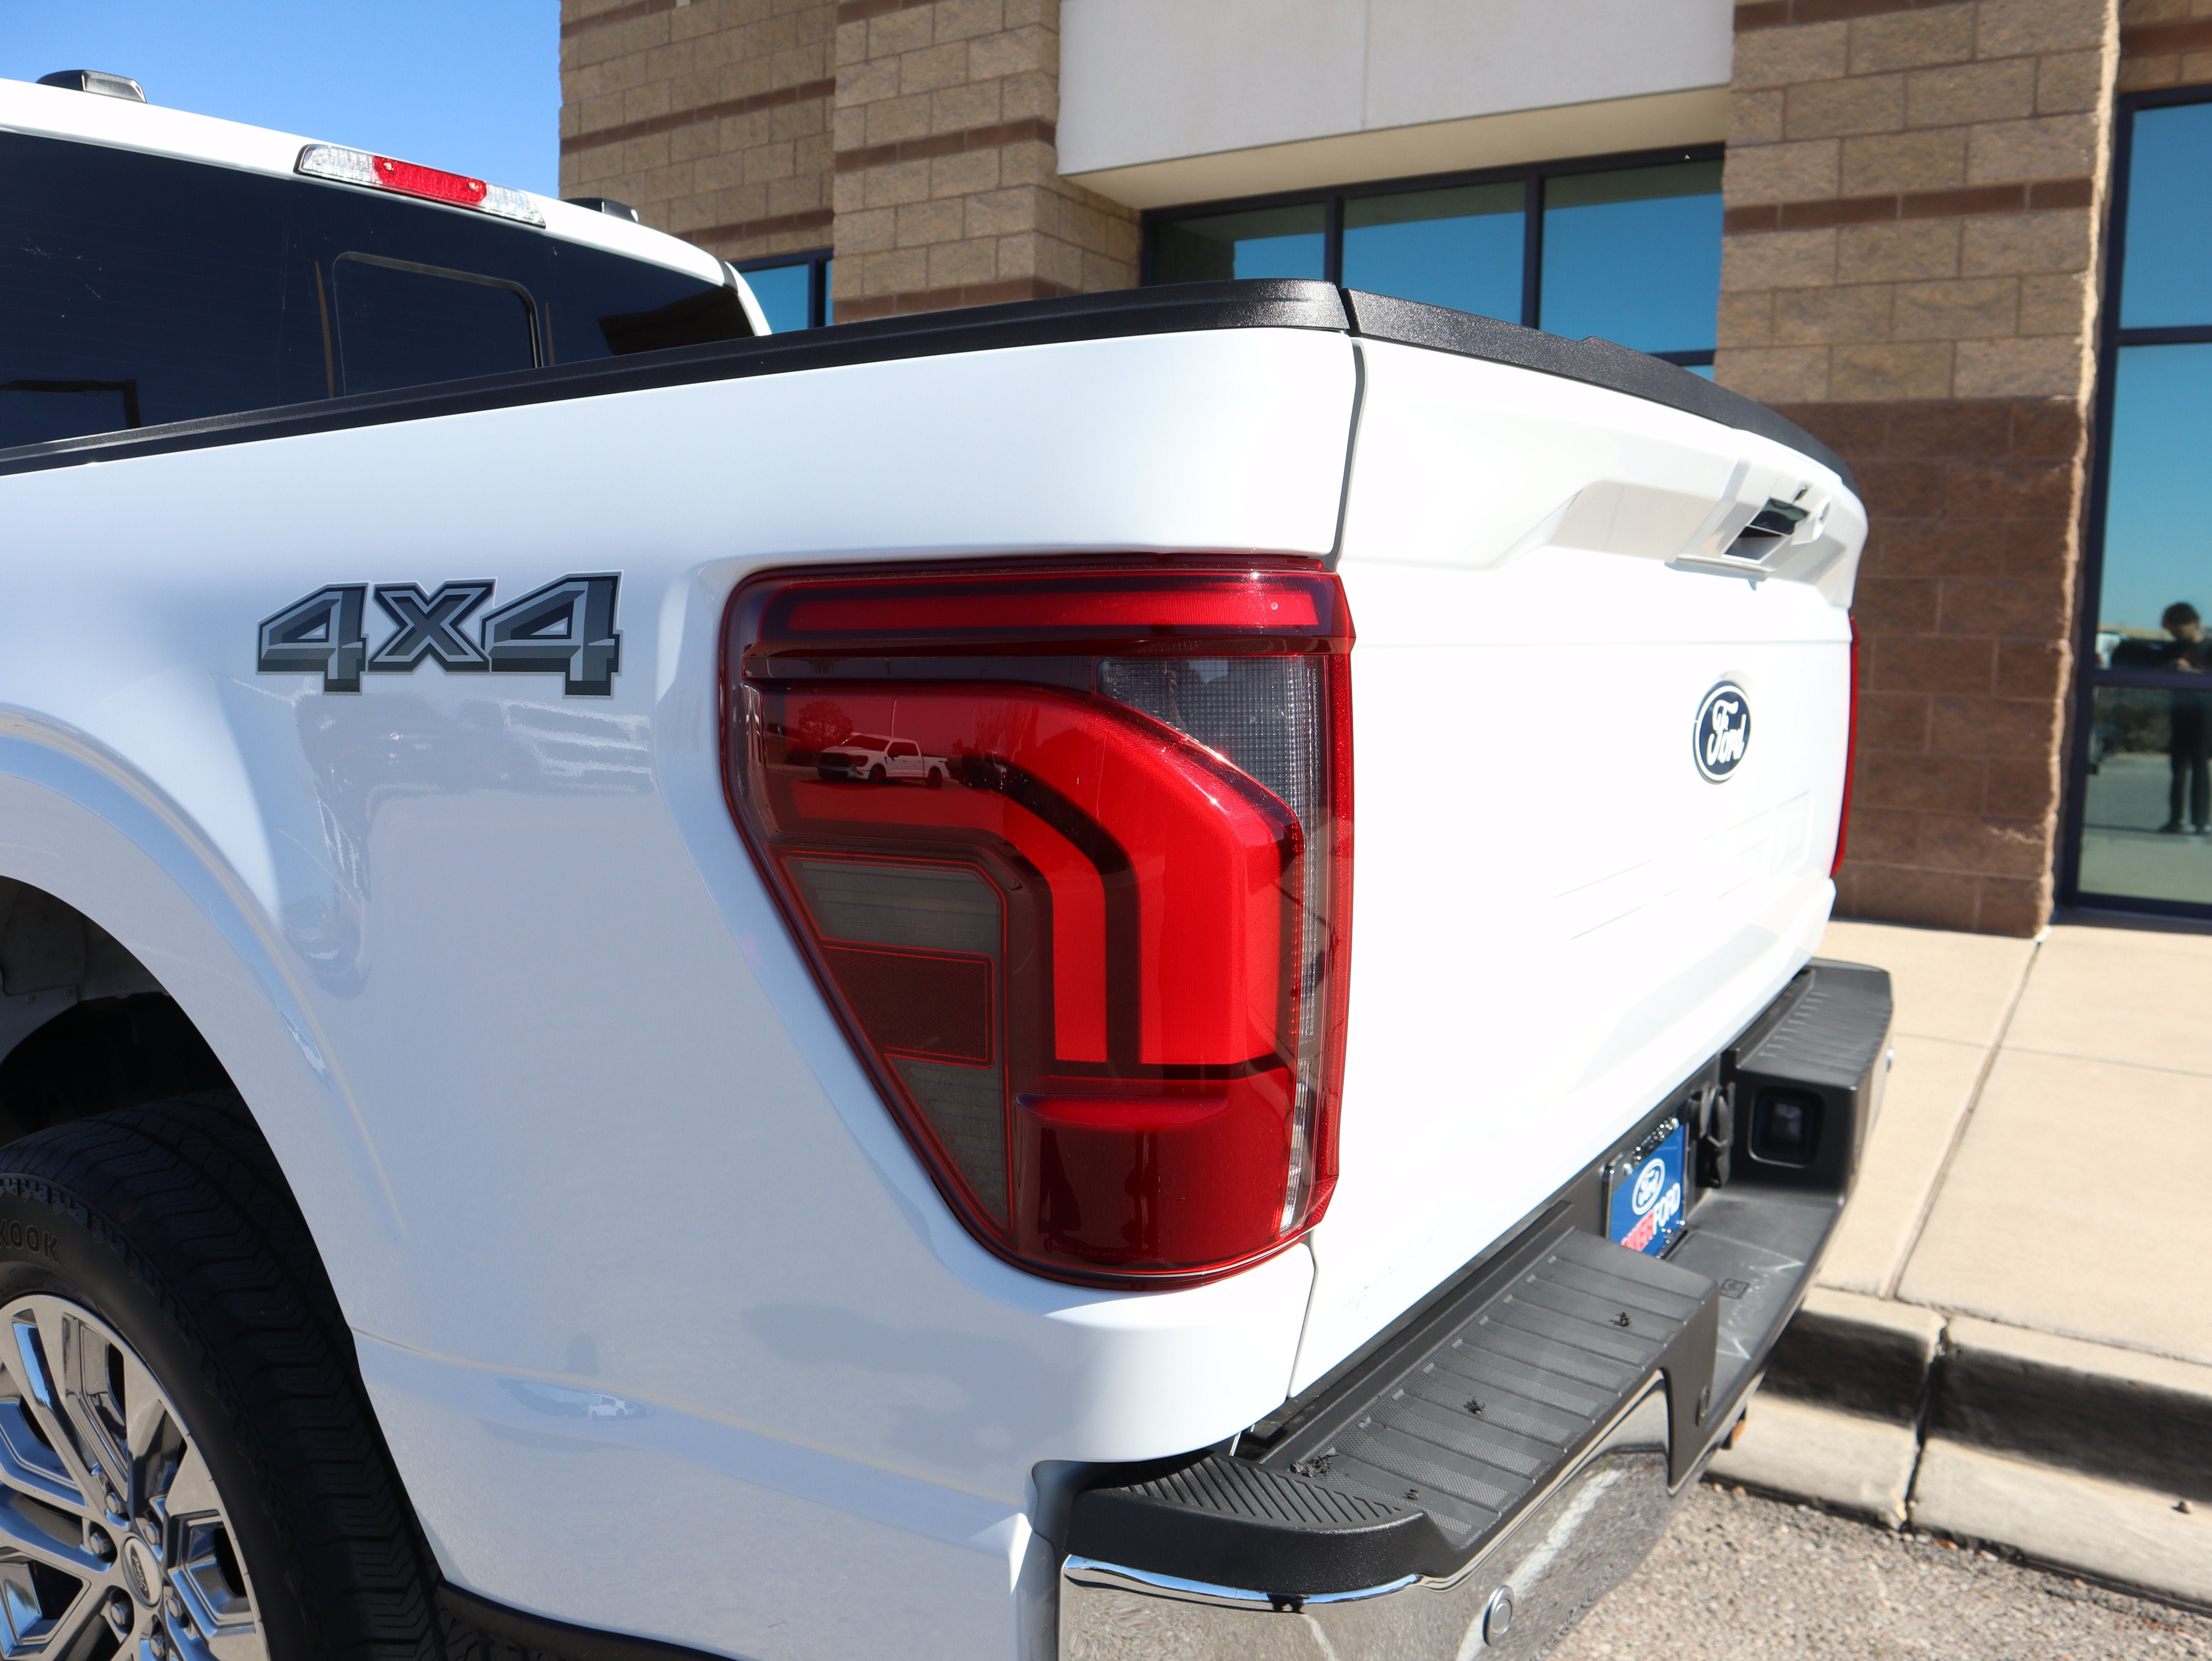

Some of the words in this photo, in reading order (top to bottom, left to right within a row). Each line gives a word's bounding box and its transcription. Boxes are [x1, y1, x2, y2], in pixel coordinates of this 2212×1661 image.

[1706, 700, 1747, 765] Ford
[844, 918, 984, 944] FORD
[132, 1556, 148, 1591] Ford
